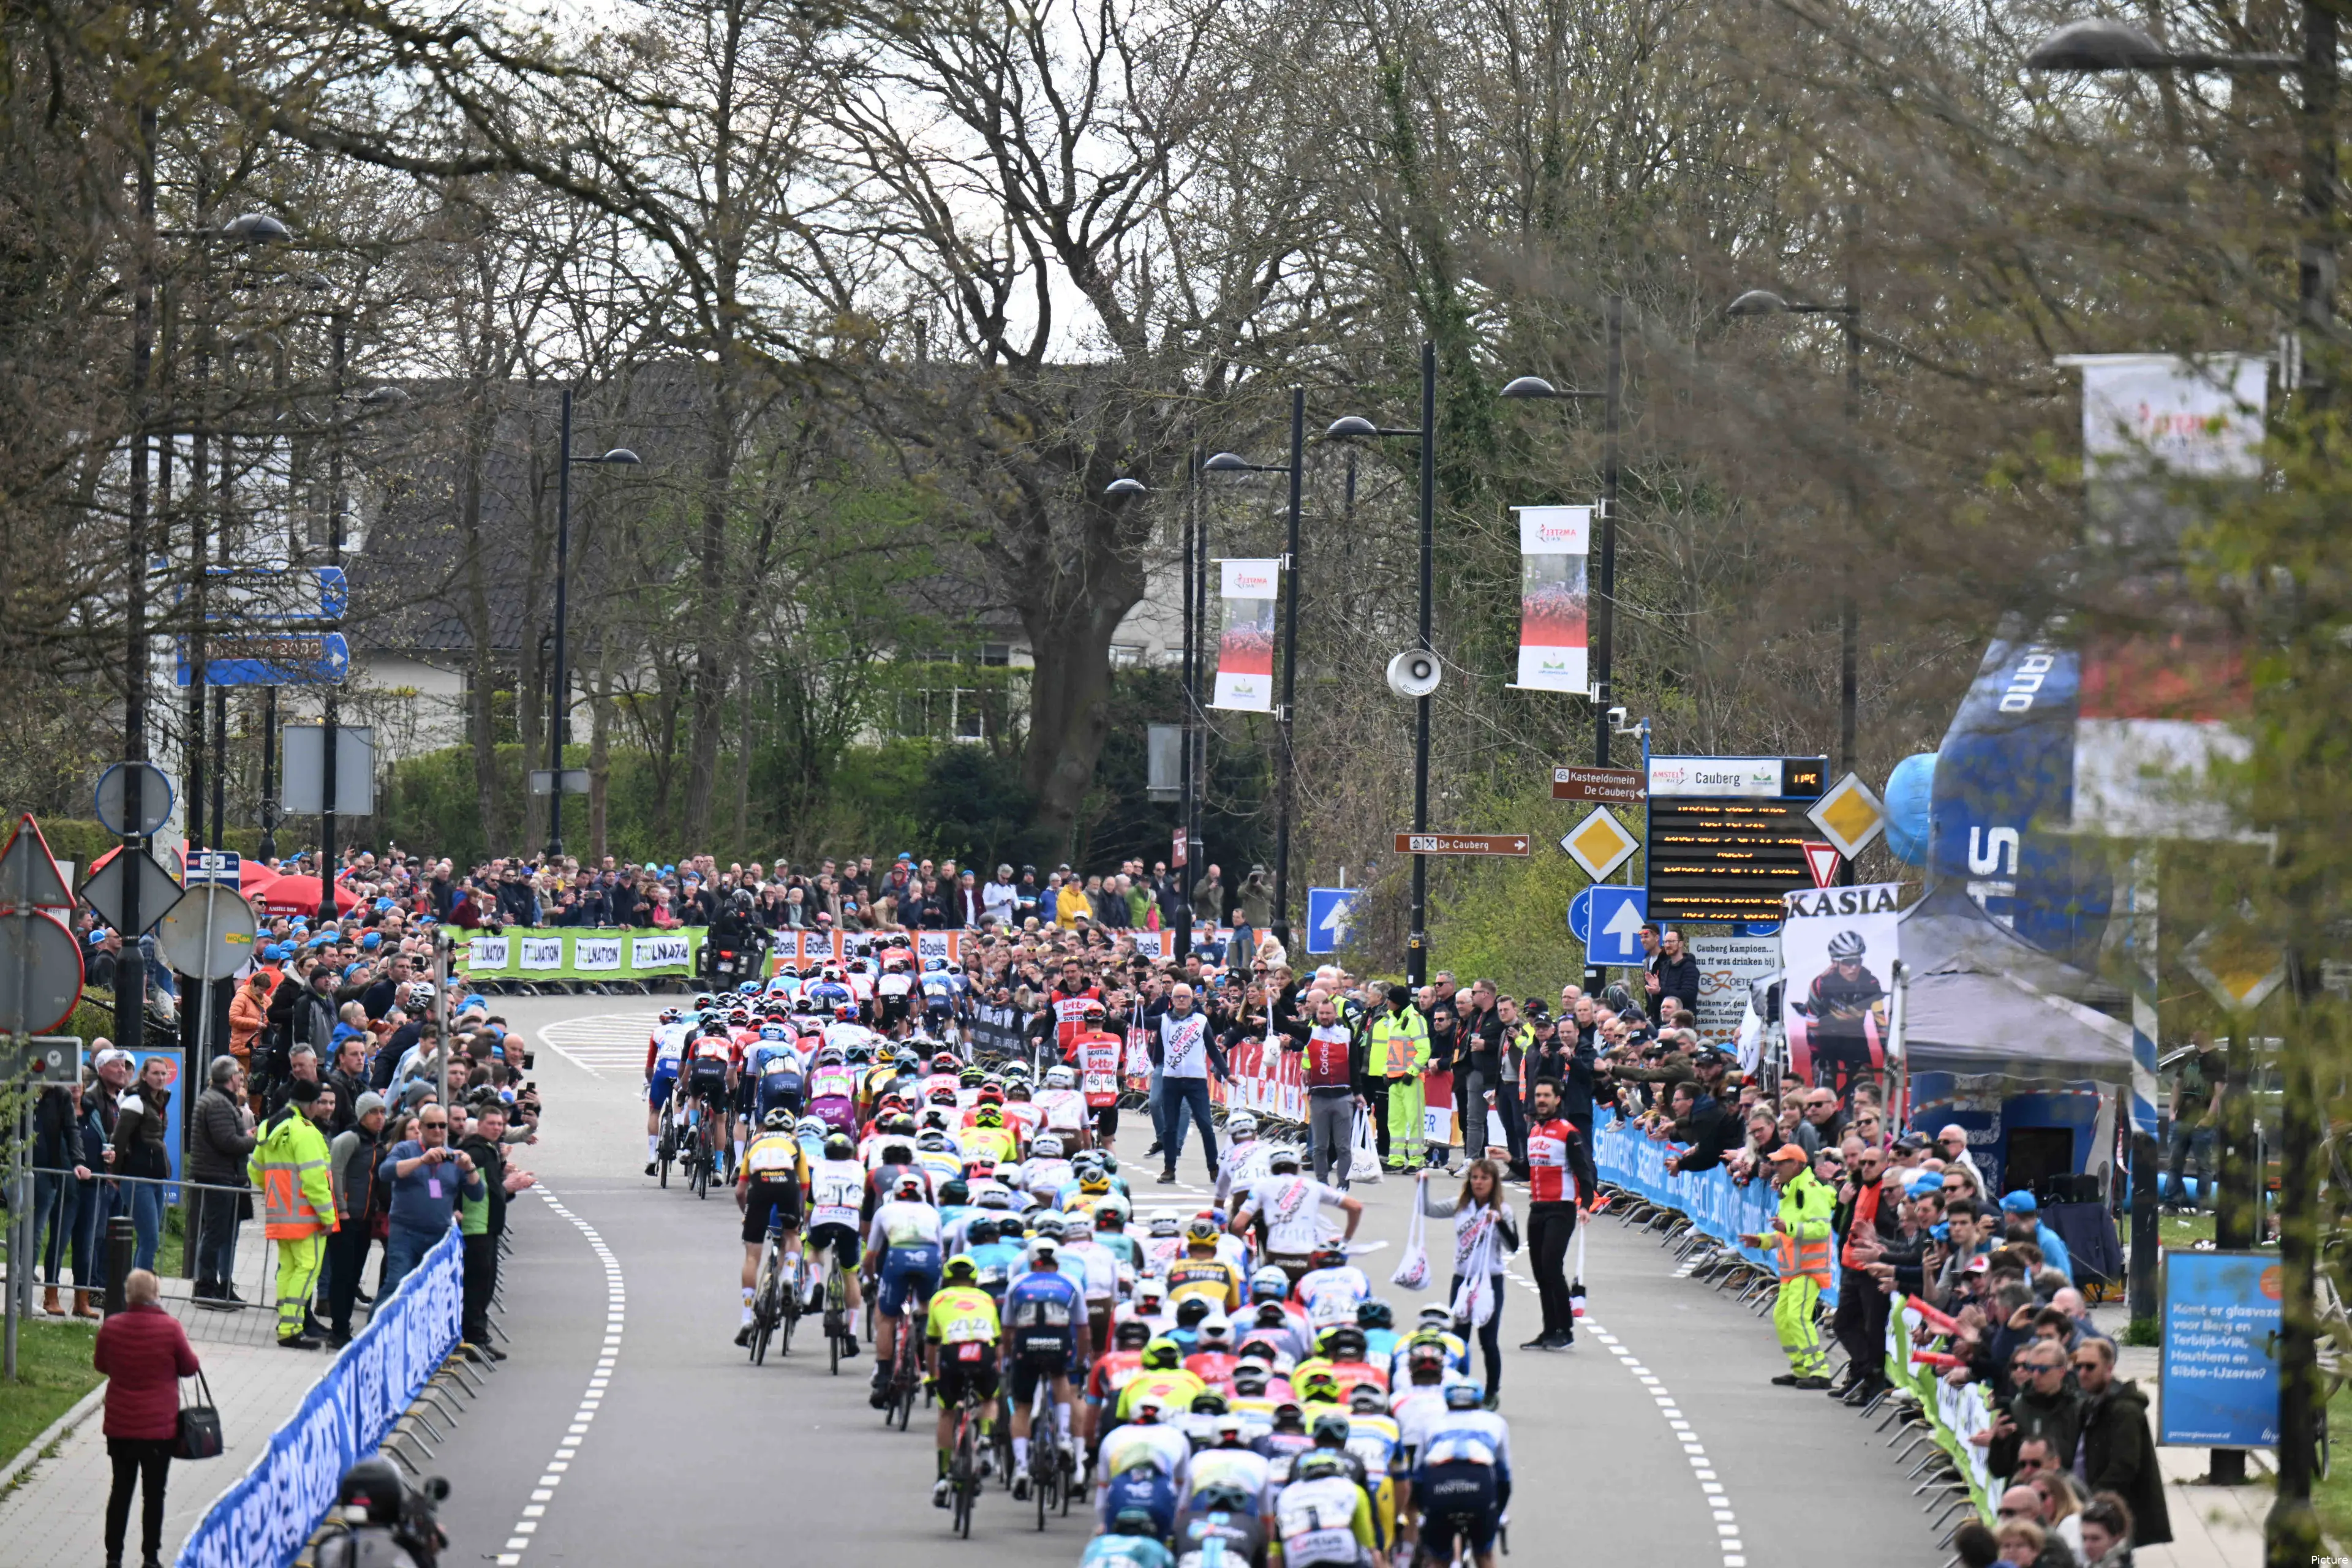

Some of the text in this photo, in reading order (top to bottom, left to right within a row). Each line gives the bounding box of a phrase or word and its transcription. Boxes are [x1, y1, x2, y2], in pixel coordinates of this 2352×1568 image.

[1404, 649, 1433, 658] FRANZEN
[1402, 684, 1432, 695] BOCHOLTZ
[1570, 772, 1635, 785] Kasteeldomein
[1695, 772, 1740, 786] Cauberg
[1585, 785, 1635, 800] De Cauberg
[1453, 840, 1489, 851] Cauberg
[1789, 888, 1896, 918] KASIA
[920, 938, 946, 956] Boels
[1136, 937, 1159, 955] oels
[1697, 944, 1727, 954] Cauberg
[1732, 957, 1762, 966] drinken
[1765, 958, 1775, 968] bij
[1701, 978, 1712, 986] DE
[1063, 1001, 1087, 1011] Lotto
[665, 1044, 676, 1052] 26
[1170, 1030, 1201, 1070] MONDIALE
[1321, 1042, 1329, 1075] Cofidis
[1087, 1074, 1115, 1086] 46 46
[2173, 1303, 2207, 1316] Komt
[2210, 1306, 2223, 1315] er
[2173, 1319, 2251, 1335] voor Berg en
[2171, 1350, 2248, 1364] Houthem en
